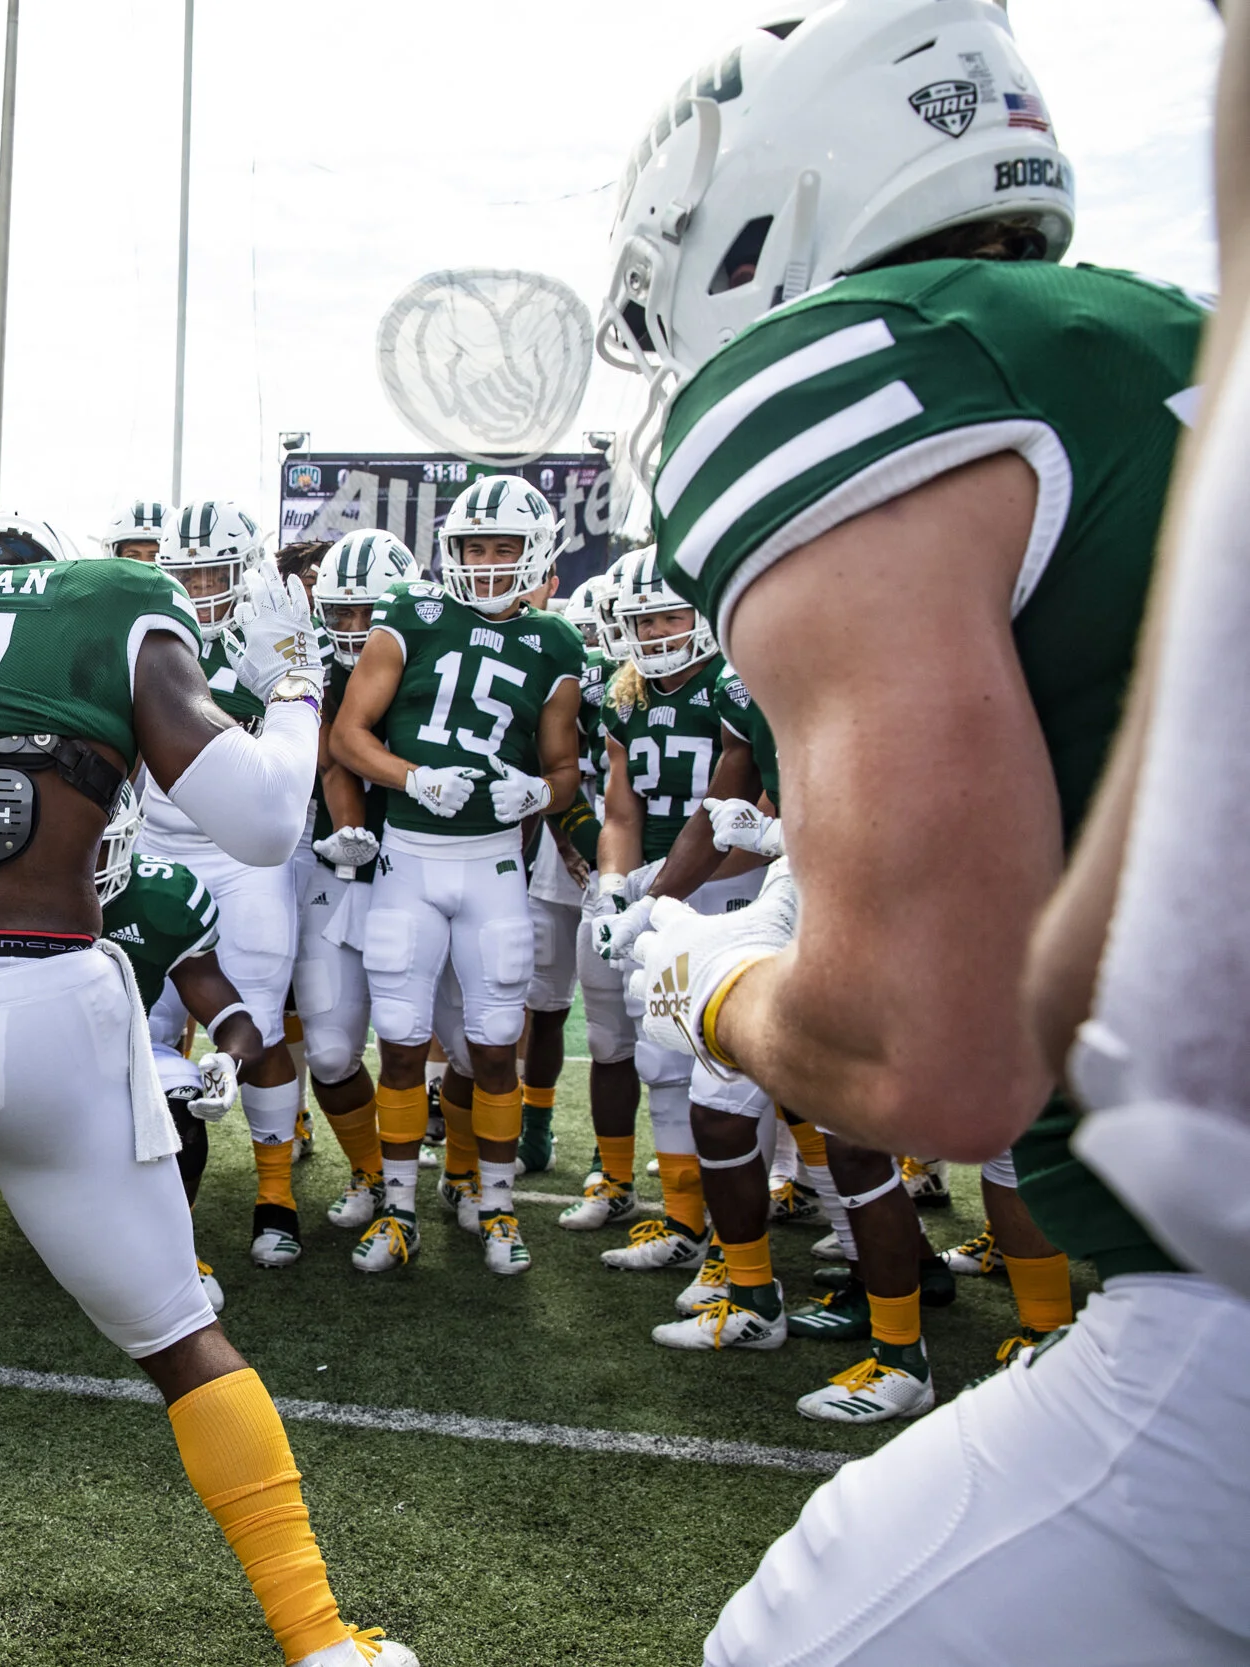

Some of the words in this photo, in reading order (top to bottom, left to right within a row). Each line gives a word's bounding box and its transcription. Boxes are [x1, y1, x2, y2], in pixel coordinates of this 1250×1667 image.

[920, 95, 976, 120] MAC
[290, 466, 321, 487] OHIO
[423, 464, 467, 483] 31:18
[540, 469, 554, 490] 0
[469, 627, 505, 654] OHIO
[518, 636, 543, 654] adidas
[416, 649, 528, 756] 15
[689, 697, 711, 707] adidas
[647, 705, 677, 729] OHIO
[627, 735, 714, 818] 27
[422, 789, 441, 807] adidas
[518, 799, 539, 814] adidas
[731, 821, 760, 830] adida
[137, 854, 175, 880] 98
[110, 931, 145, 945] adidas
